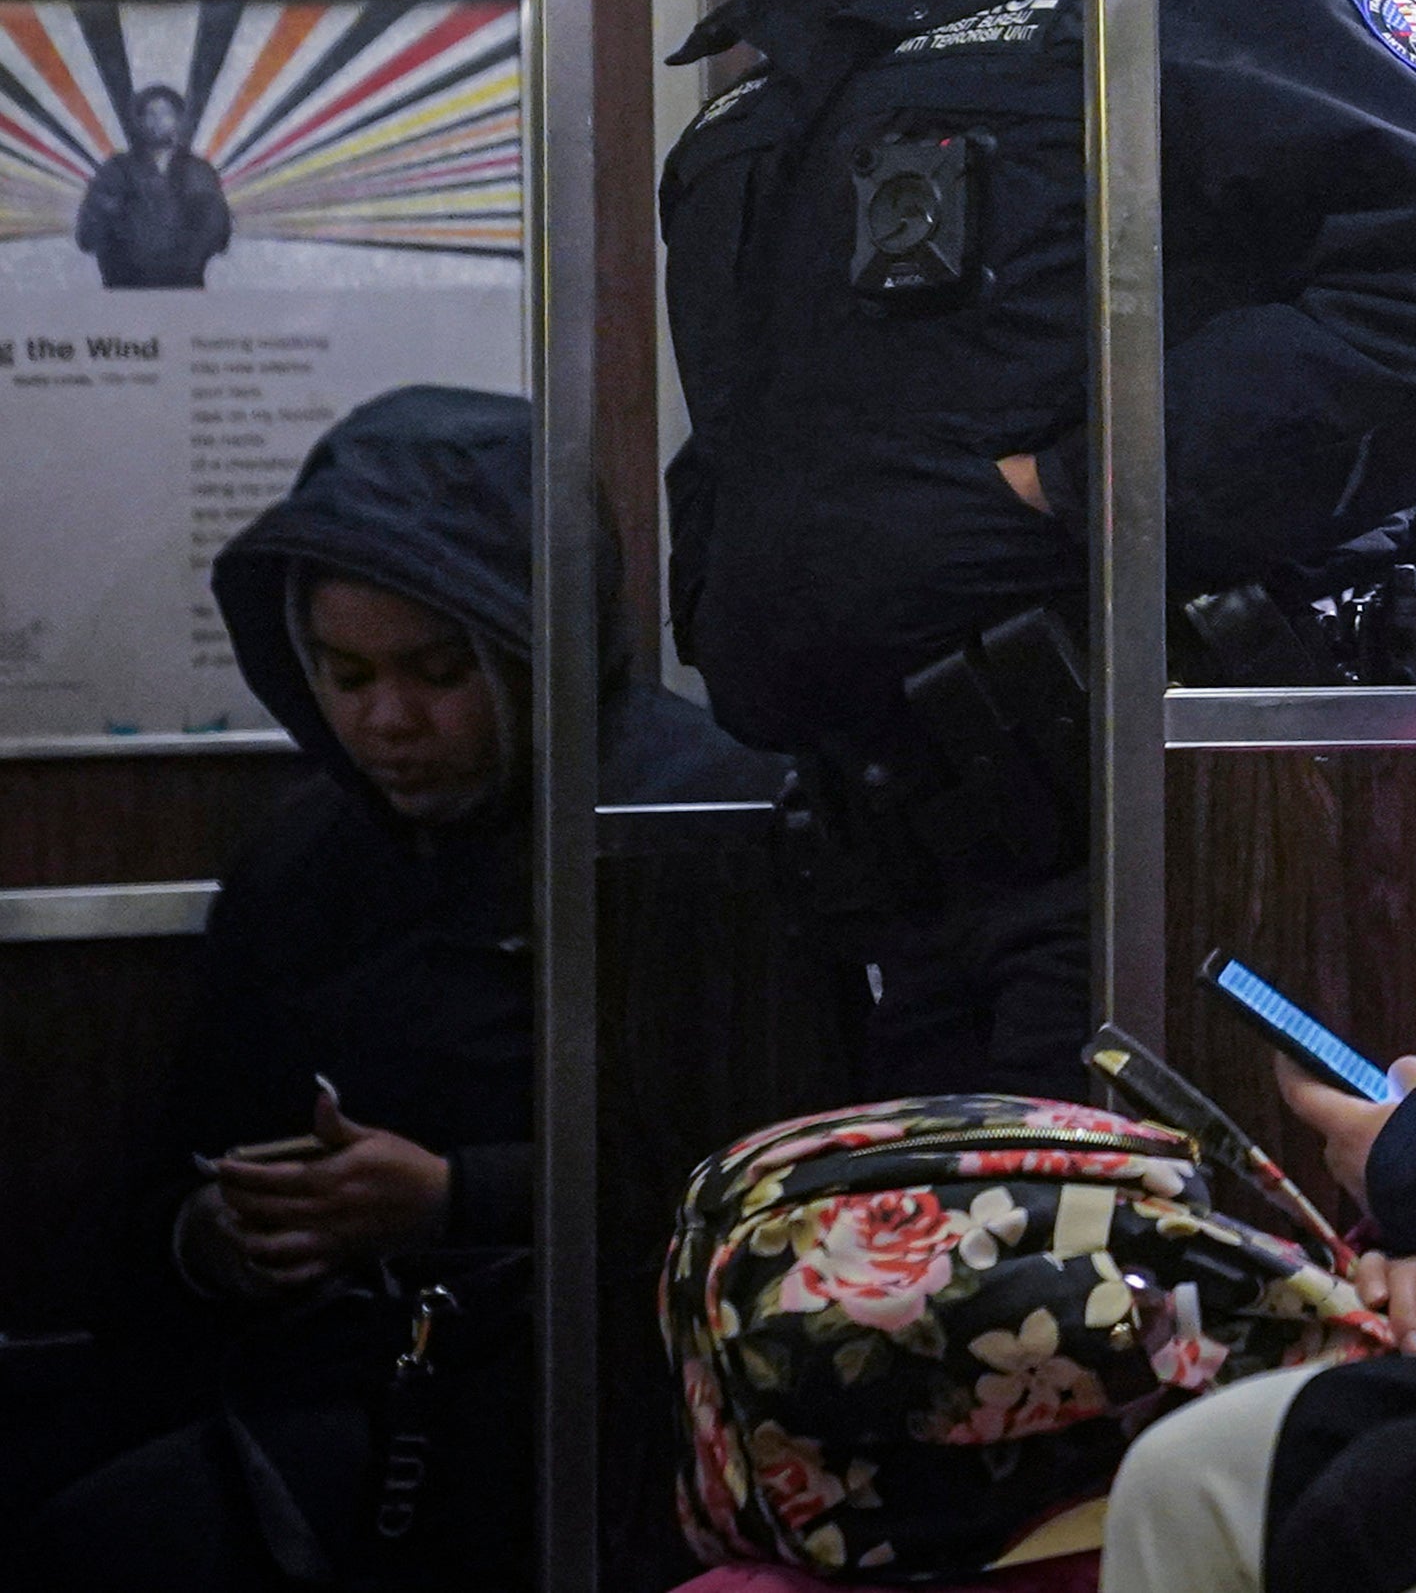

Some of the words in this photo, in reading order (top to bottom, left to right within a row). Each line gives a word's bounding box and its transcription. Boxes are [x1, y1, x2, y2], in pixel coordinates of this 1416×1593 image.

[1003, 24, 1040, 42] UNIT
[26, 336, 75, 362] the
[85, 335, 160, 362] Wind
